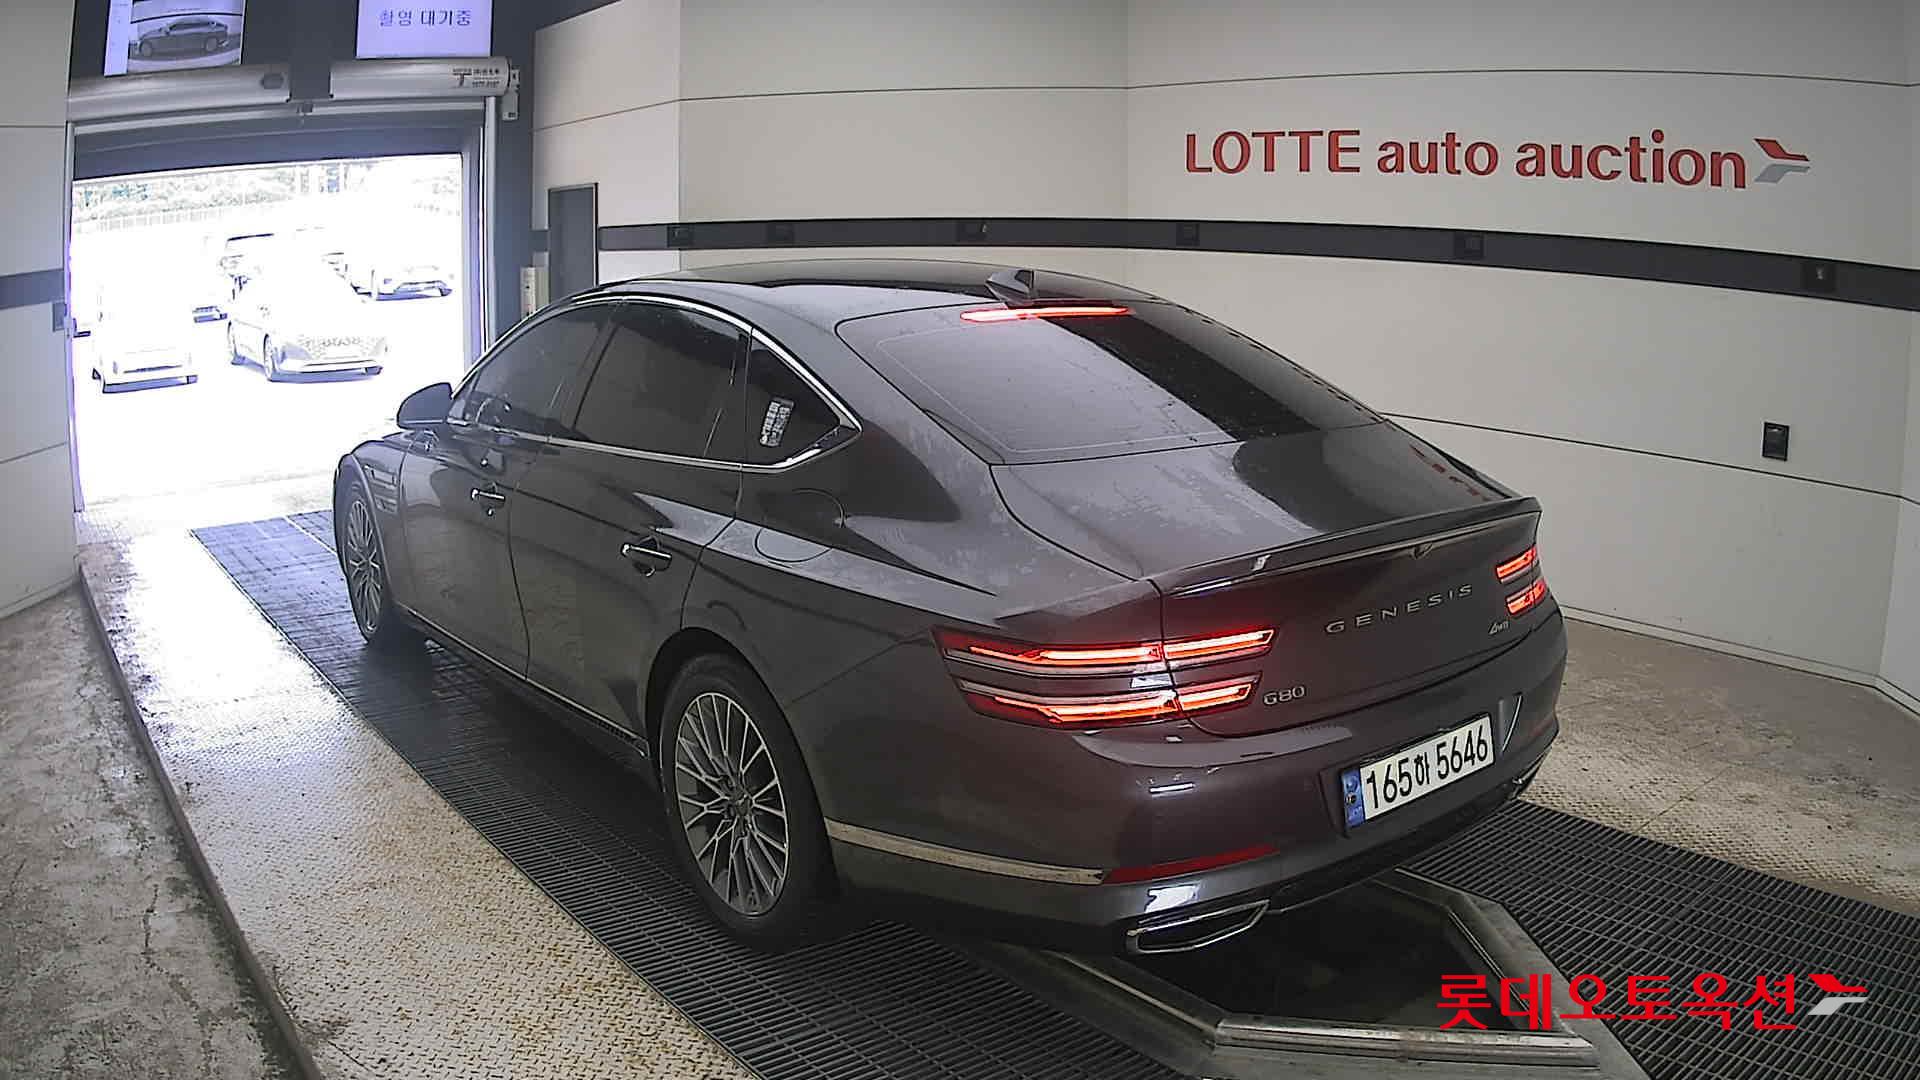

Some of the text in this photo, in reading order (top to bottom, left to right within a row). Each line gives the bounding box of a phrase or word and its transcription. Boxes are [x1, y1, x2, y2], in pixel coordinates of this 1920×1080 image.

[420, 9, 471, 26] 대기중
[1186, 129, 1746, 188] LOTTE auto auction
[1325, 583, 1473, 633] GENESIS
[1263, 685, 1305, 706] G80
[1366, 723, 1488, 809] 165하 5646
